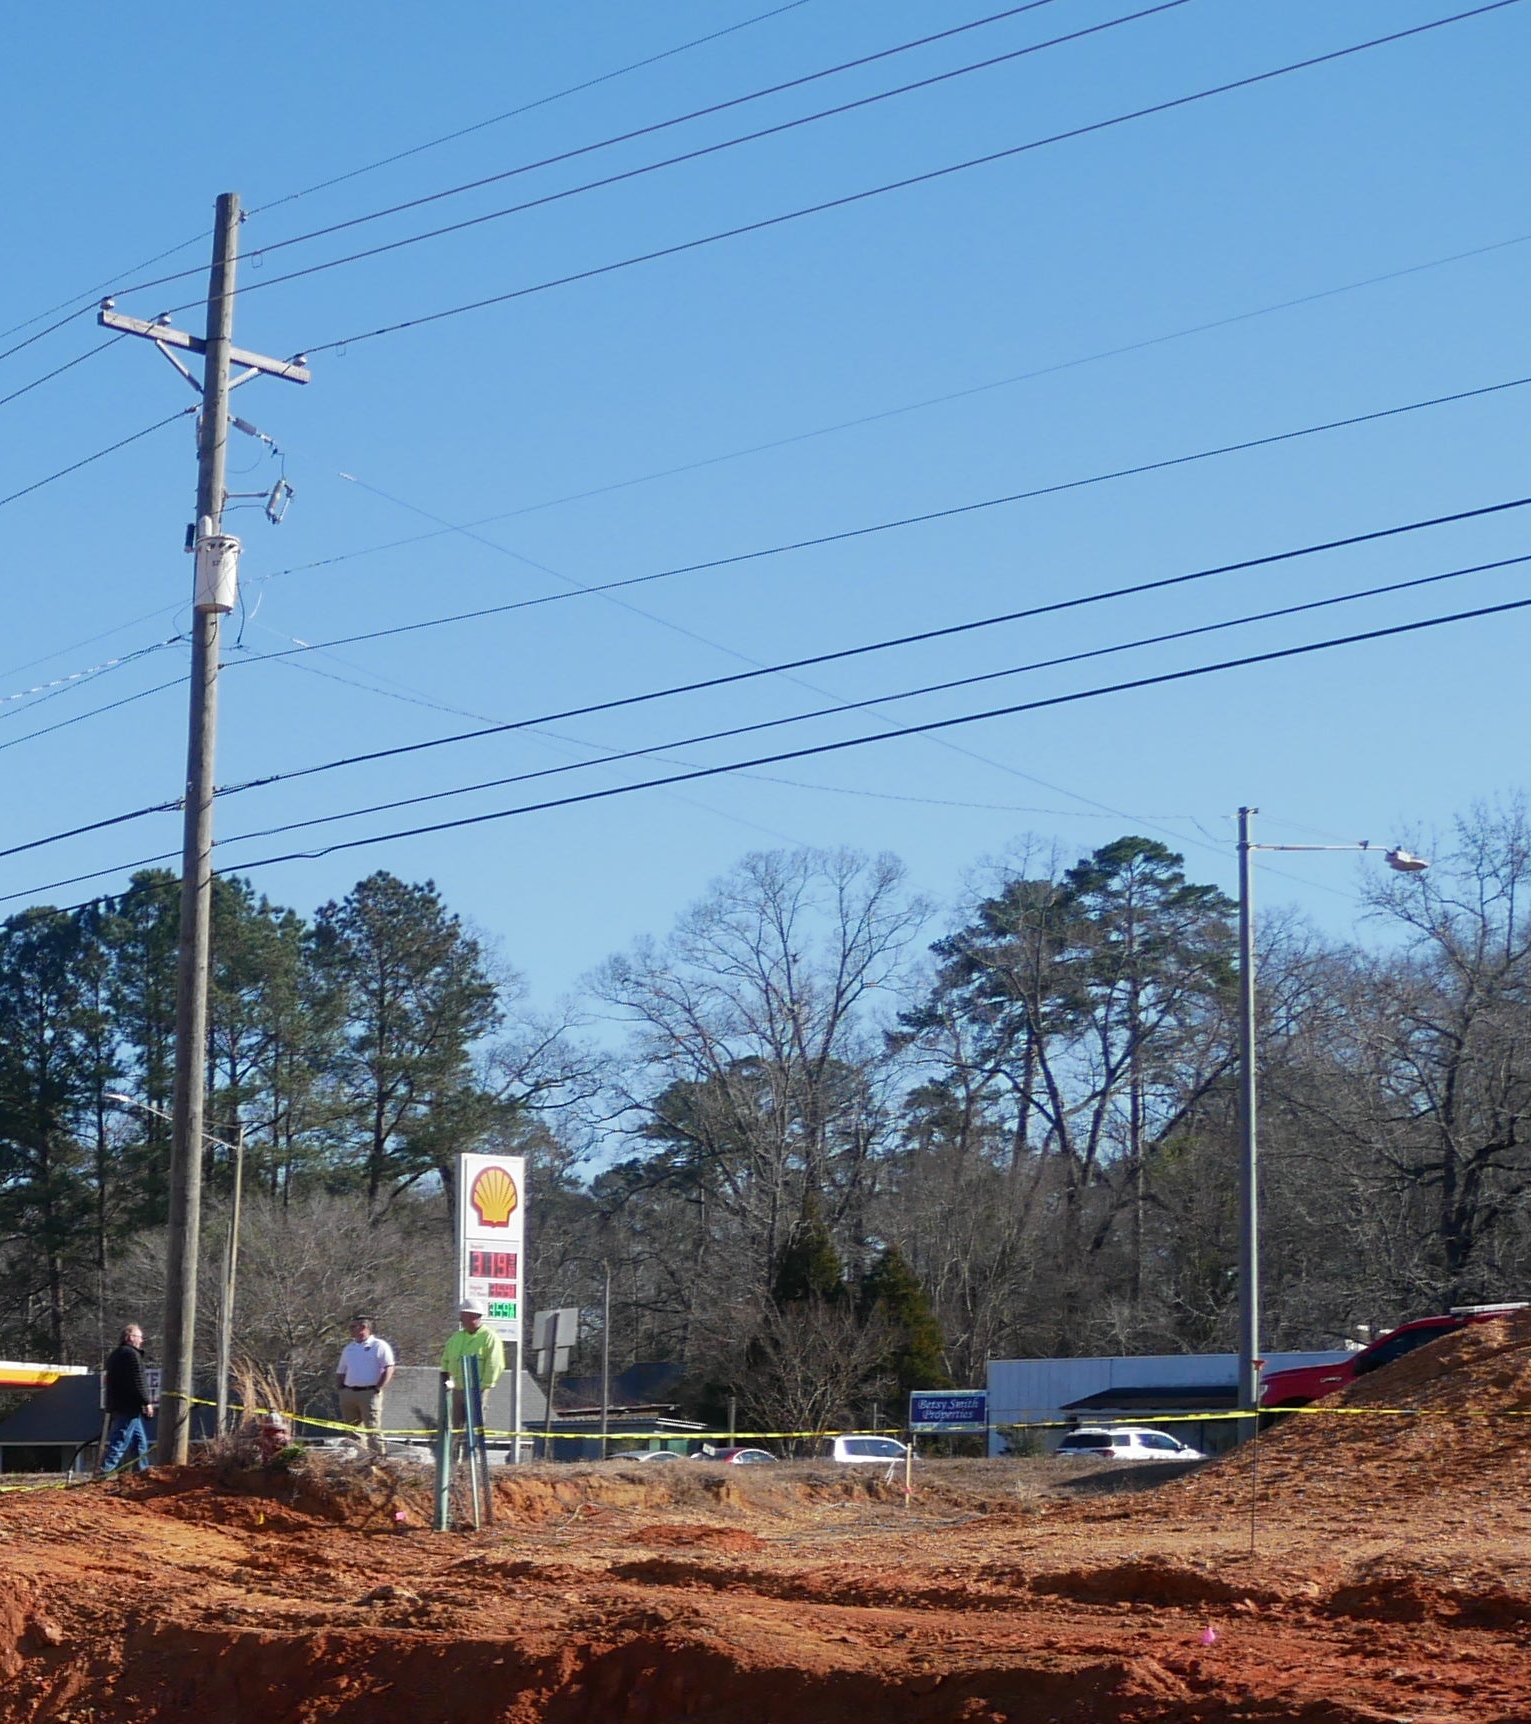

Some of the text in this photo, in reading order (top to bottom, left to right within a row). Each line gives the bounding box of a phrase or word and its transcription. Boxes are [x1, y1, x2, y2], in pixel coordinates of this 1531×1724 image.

[918, 1398, 978, 1411] Betsy Smith
[923, 1410, 974, 1422] Properties
